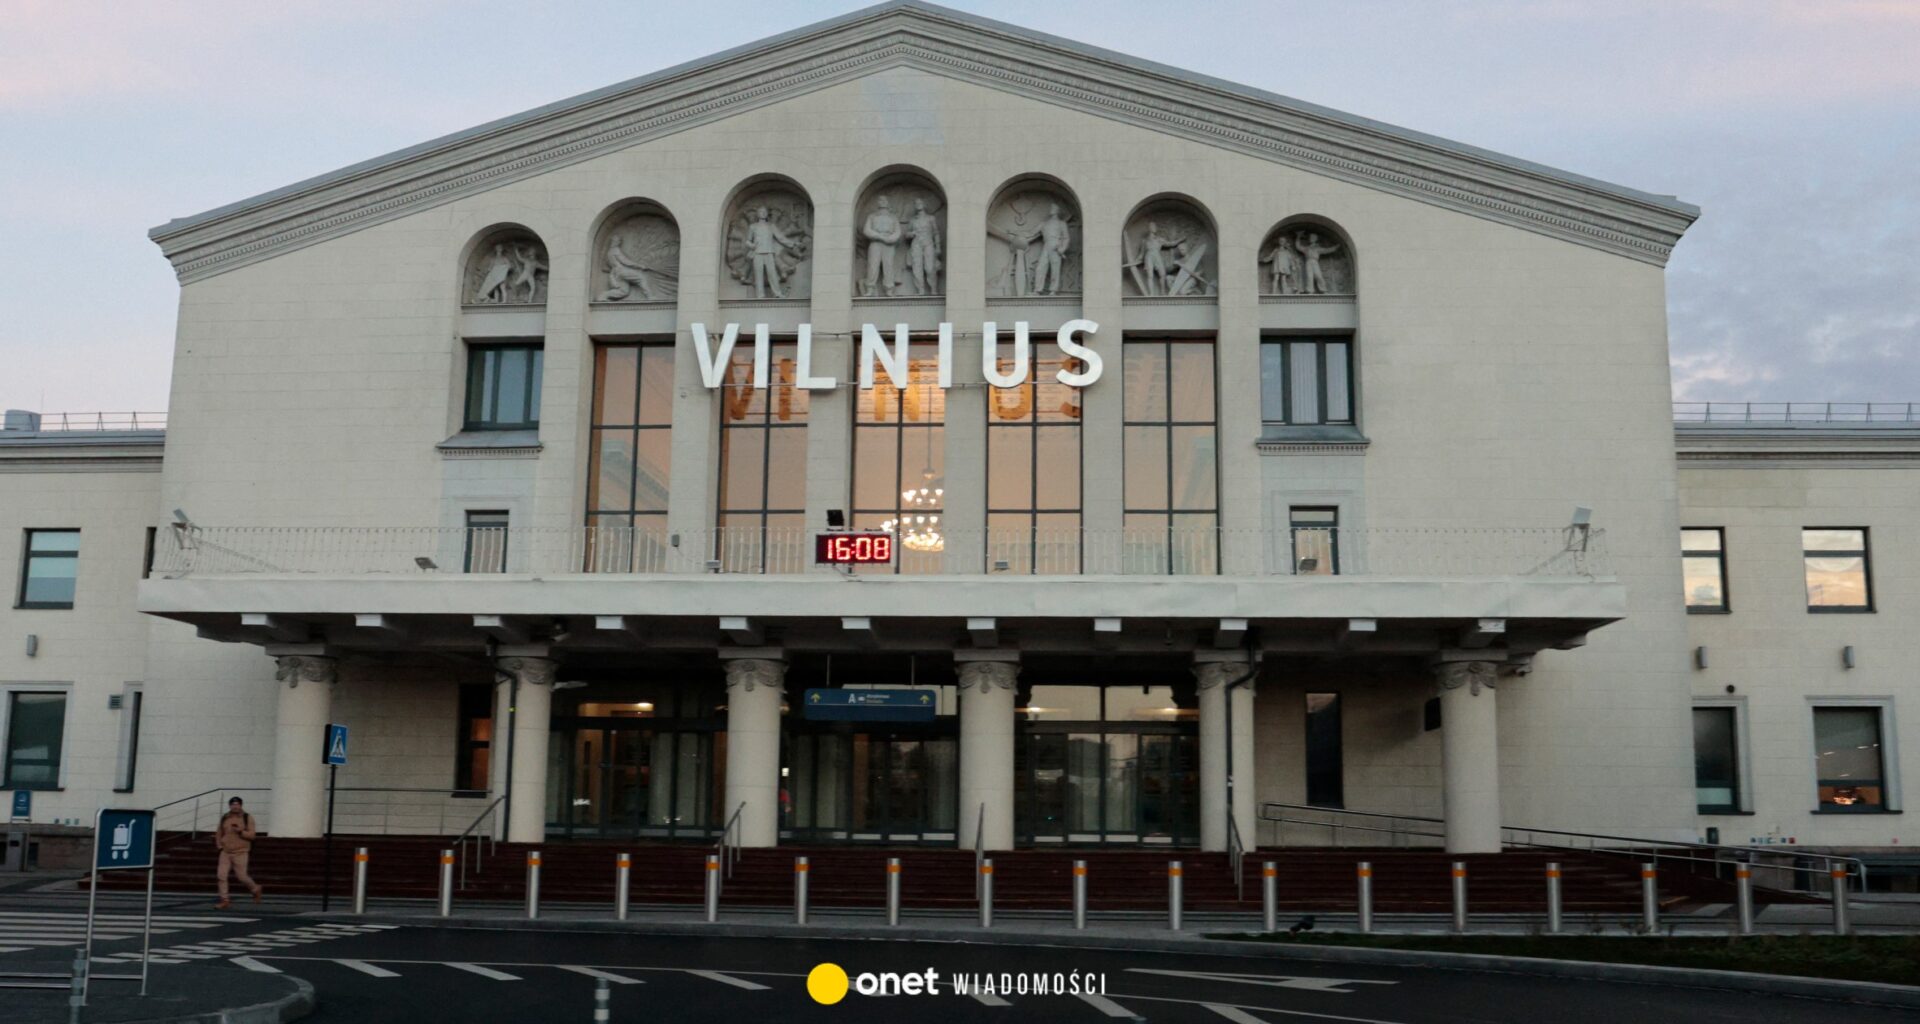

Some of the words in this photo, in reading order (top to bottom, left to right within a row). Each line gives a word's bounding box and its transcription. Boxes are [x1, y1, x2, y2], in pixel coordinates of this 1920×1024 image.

[691, 319, 1104, 389] VILNIUS
[827, 537, 890, 560] 16:08
[848, 693, 857, 704] A
